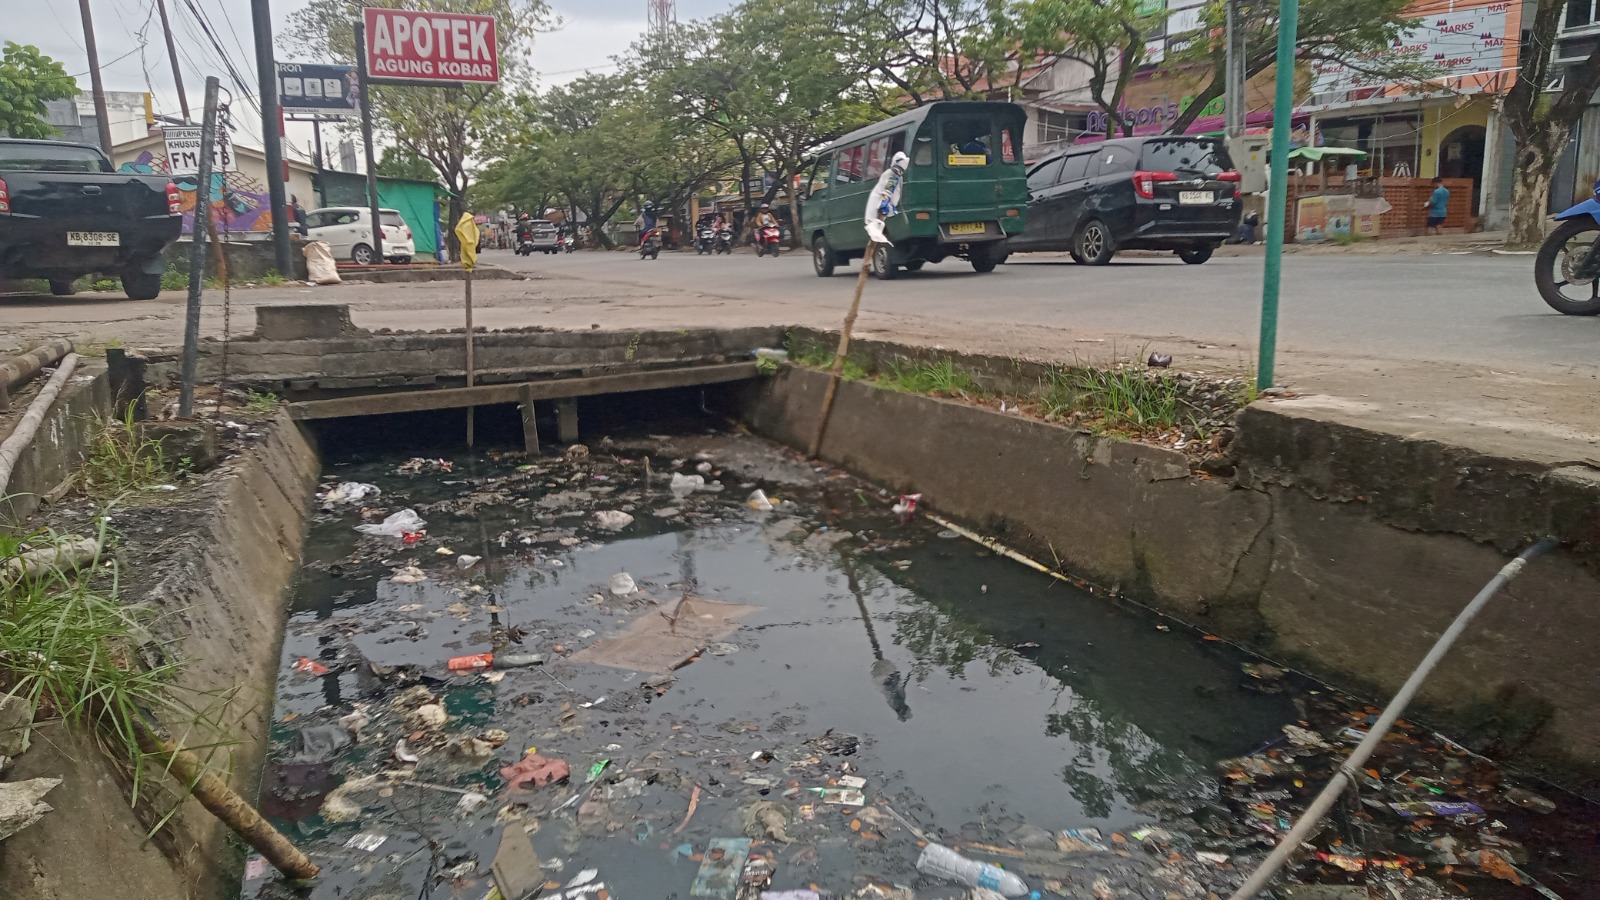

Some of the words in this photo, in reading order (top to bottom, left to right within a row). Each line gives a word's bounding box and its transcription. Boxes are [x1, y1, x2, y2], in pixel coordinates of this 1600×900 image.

[1440, 22, 1474, 34] MARKS
[373, 14, 492, 61] APOTEK
[375, 58, 433, 74] AGUNG
[438, 62, 493, 77] KOBAR
[168, 140, 201, 149] KHUSUS
[70, 232, 81, 241] KB
